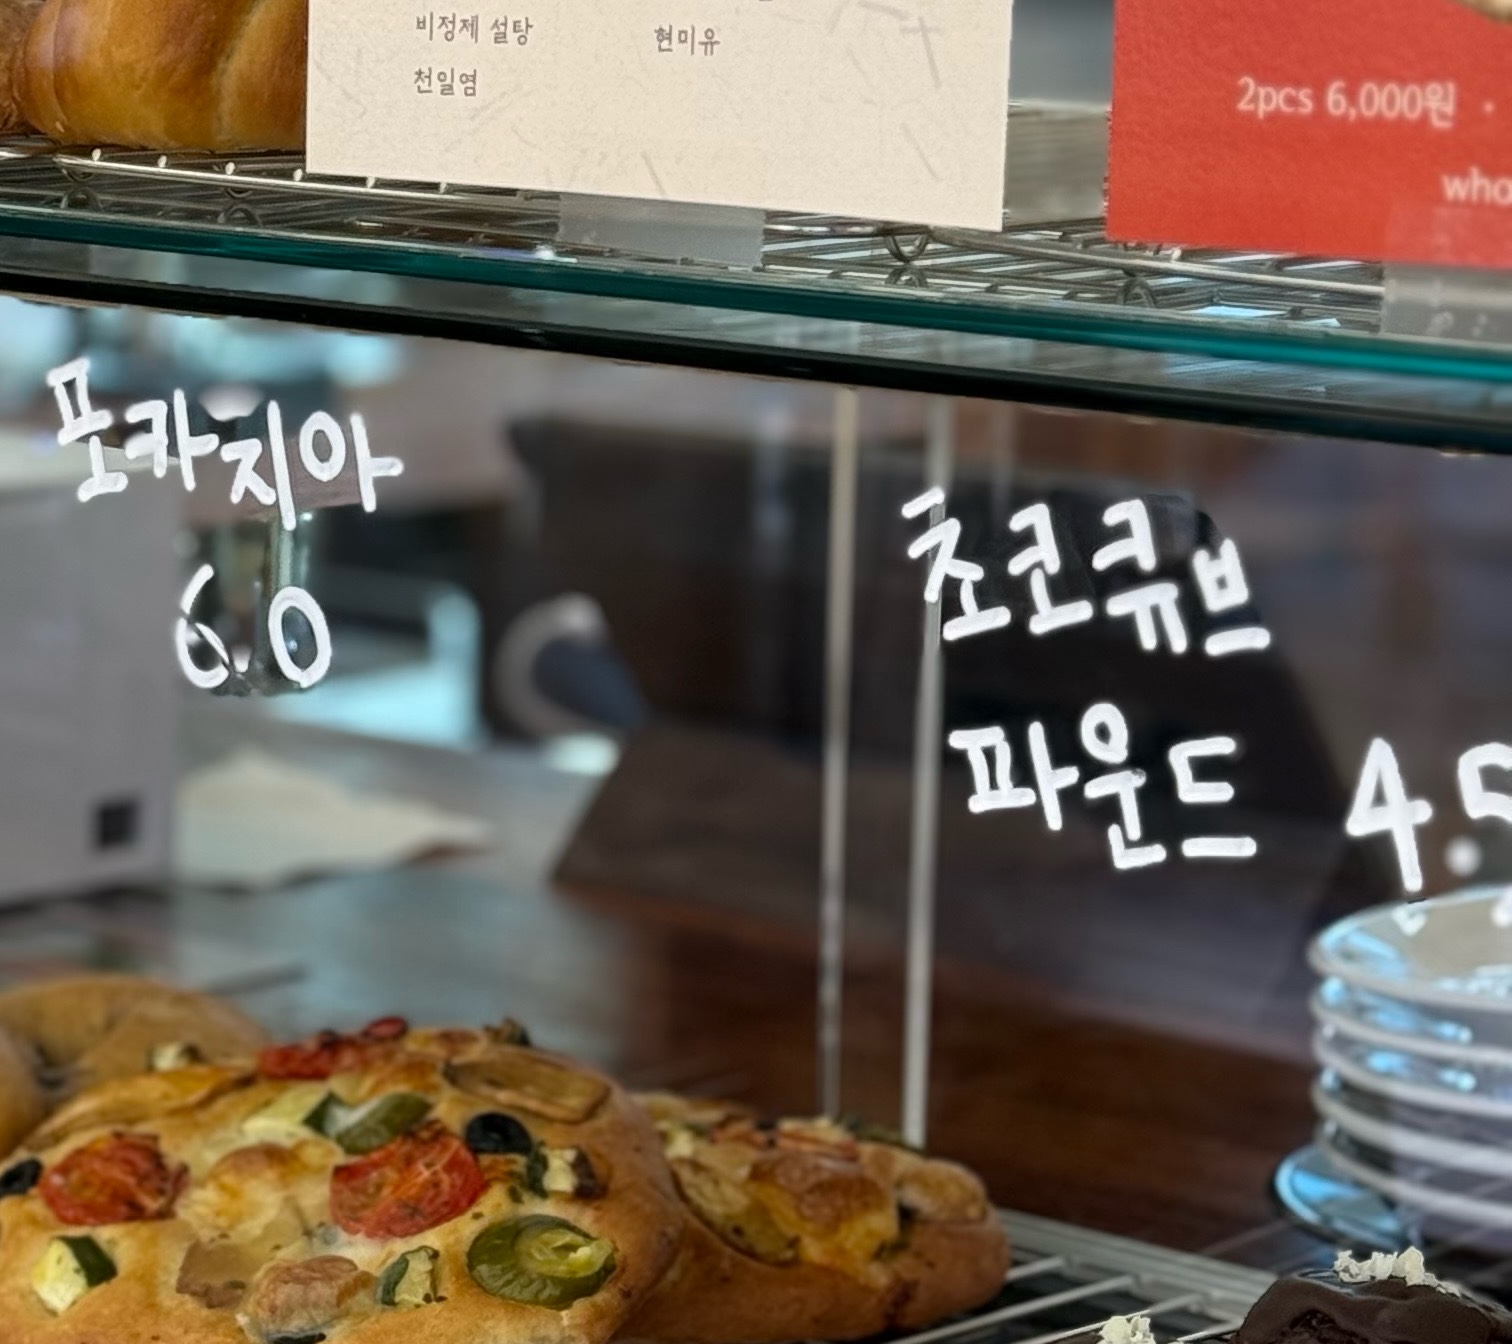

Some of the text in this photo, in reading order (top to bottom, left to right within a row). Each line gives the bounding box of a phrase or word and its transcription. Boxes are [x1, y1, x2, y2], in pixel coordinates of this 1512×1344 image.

[415, 11, 534, 47] 비정제 설탕
[653, 24, 721, 57] 현미유
[413, 66, 478, 98] 천일염
[1235, 75, 1456, 129] 2pcs 6,000원
[46, 357, 404, 531] 포카지아
[901, 486, 1271, 656] 초코큐브
[175, 564, 332, 689] 6.0
[948, 702, 1257, 870] 파운드
